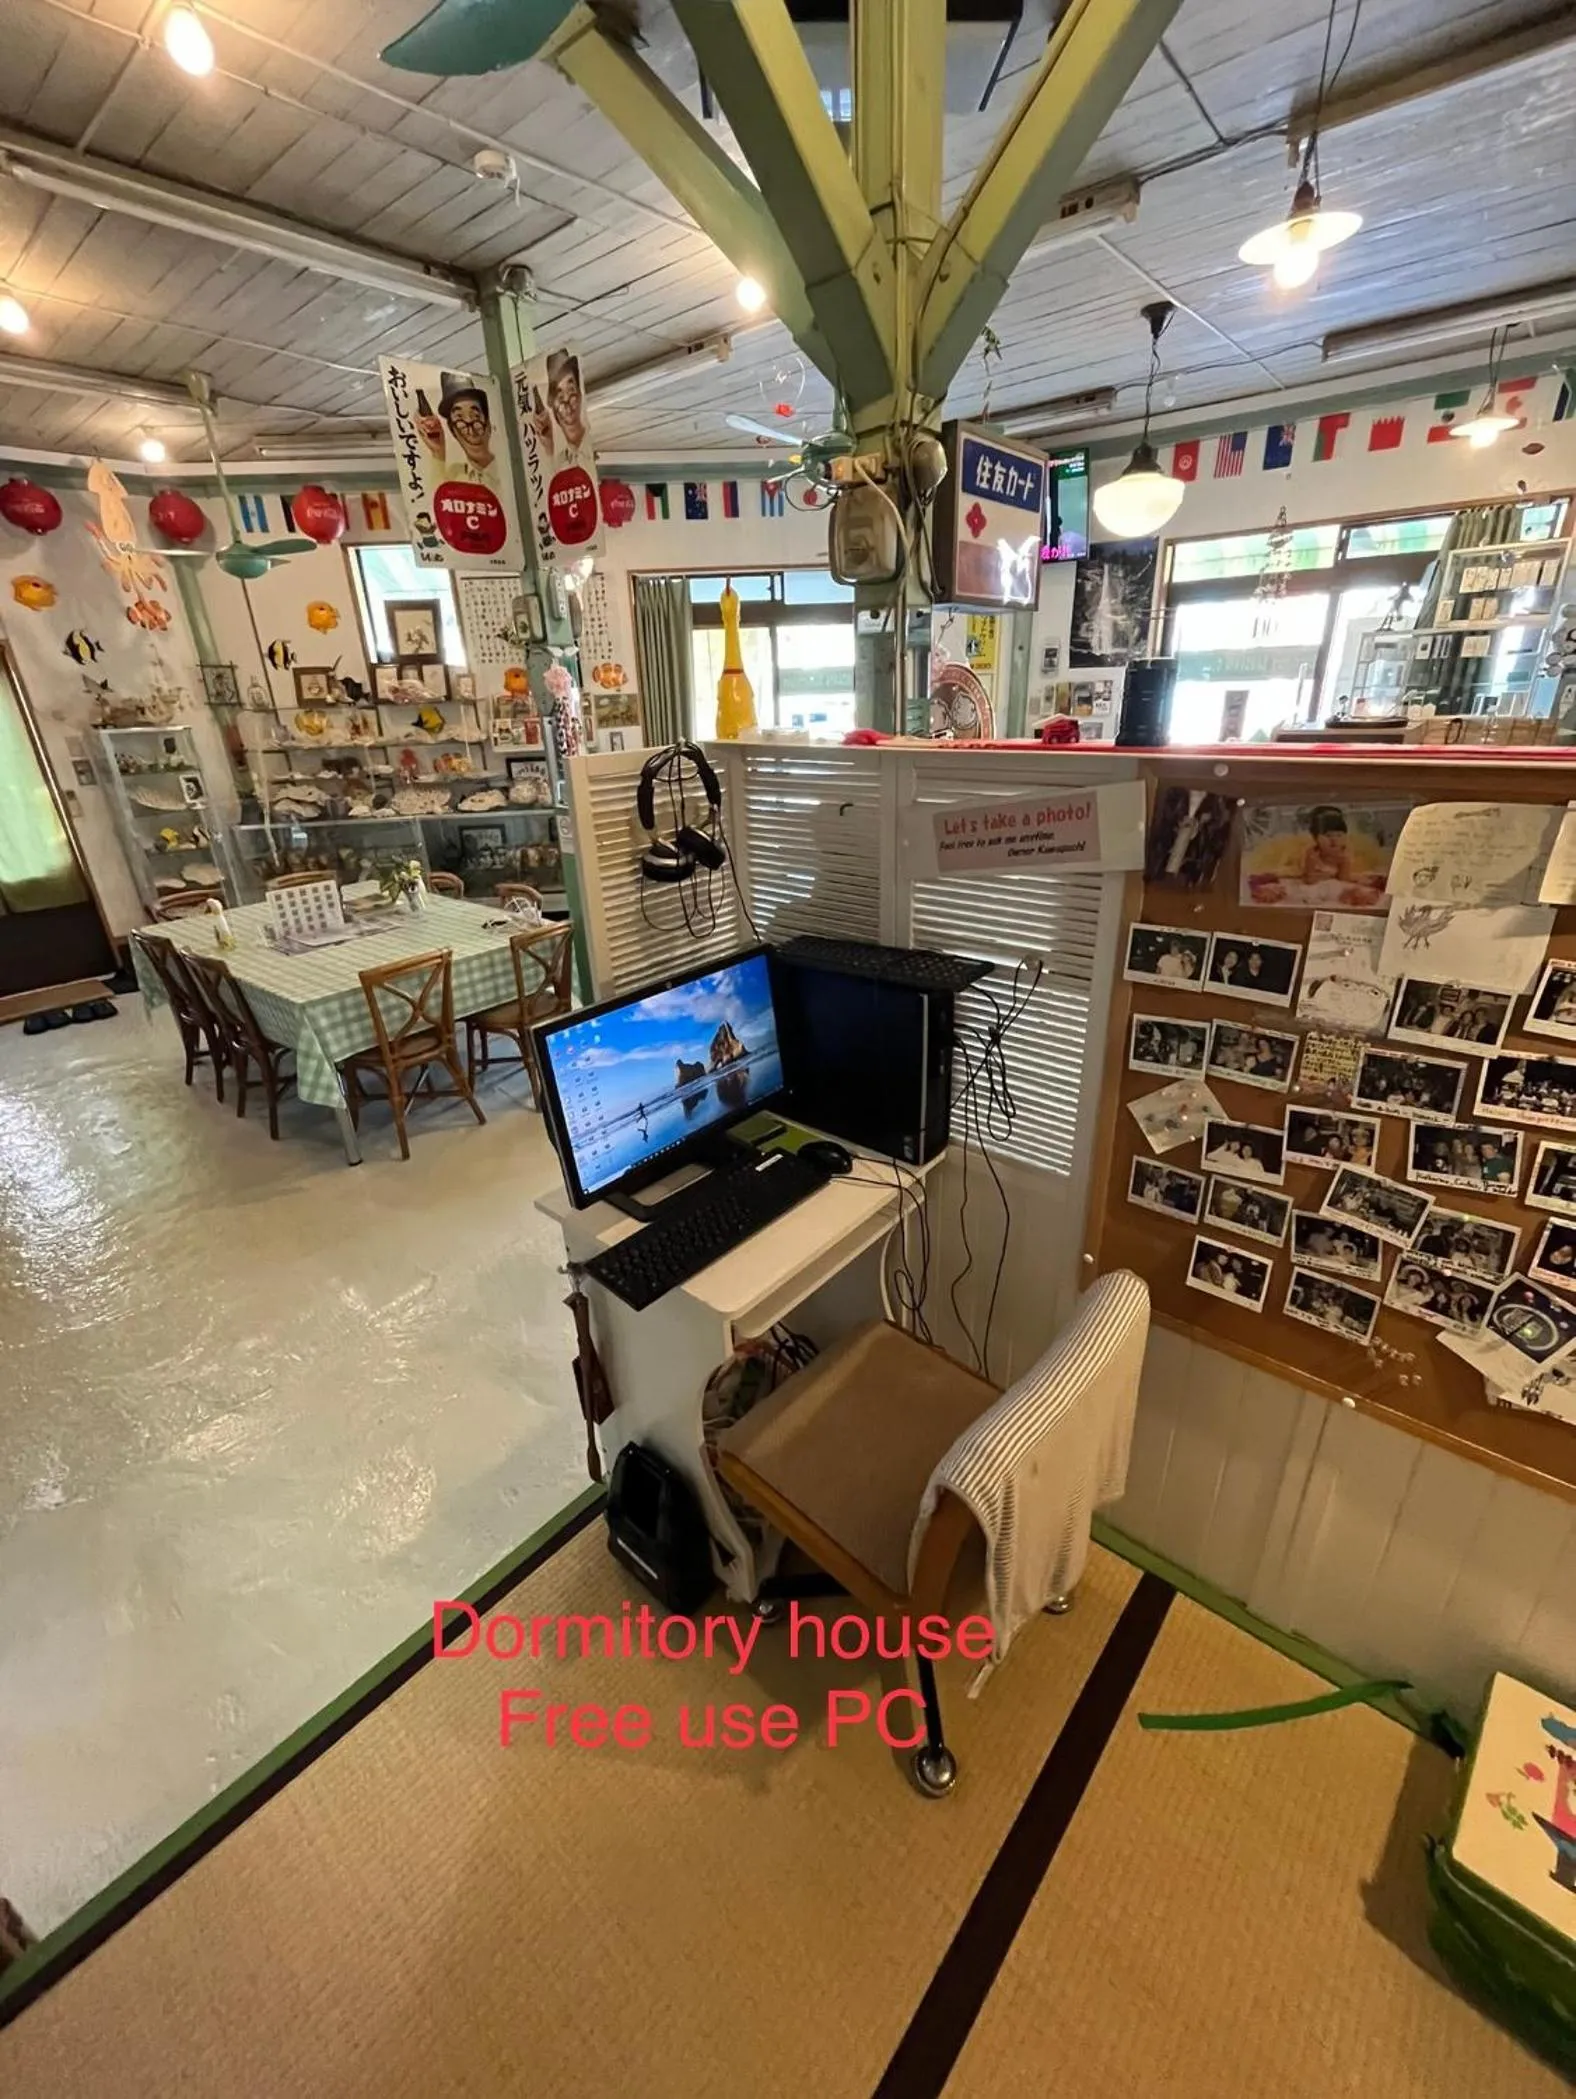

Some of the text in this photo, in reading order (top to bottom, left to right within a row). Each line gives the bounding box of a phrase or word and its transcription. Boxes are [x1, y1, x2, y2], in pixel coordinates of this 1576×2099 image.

[387, 365, 426, 503] おいしいですよ!
[551, 486, 591, 507] オロナミン
[440, 498, 498, 517] オロナミン
[568, 504, 579, 518] C
[466, 516, 480, 530] C
[983, 808, 1017, 832] take
[1022, 812, 1031, 826] a
[1037, 803, 1091, 826] photo!
